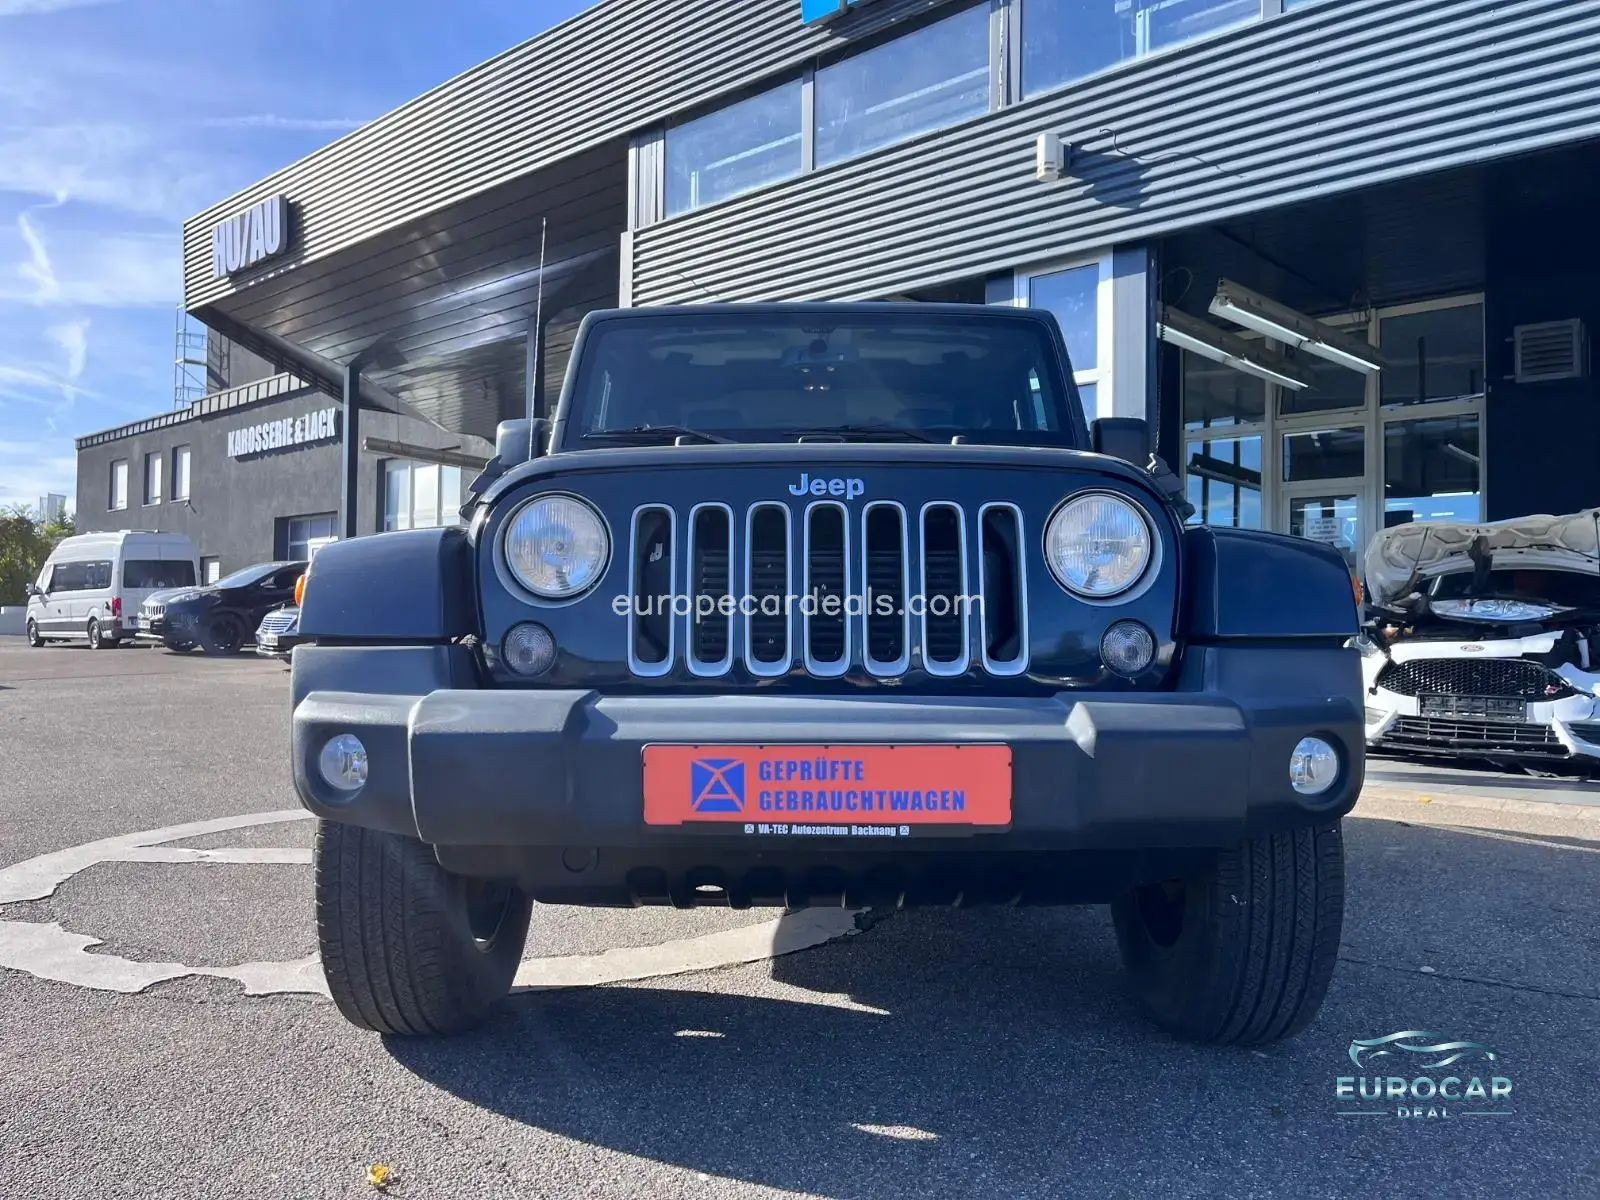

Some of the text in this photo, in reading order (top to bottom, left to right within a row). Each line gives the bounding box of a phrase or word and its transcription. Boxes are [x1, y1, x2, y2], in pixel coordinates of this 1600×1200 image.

[212, 194, 282, 280] HU/AU
[228, 407, 336, 457] KAROSSERIE & LACK
[789, 473, 865, 500] Jeep
[758, 757, 864, 781] GEPRÜFTE
[759, 790, 965, 812] GEBRAUCHTWAGEN
[758, 824, 897, 836] VA-TEC Autozentrum Backnang
